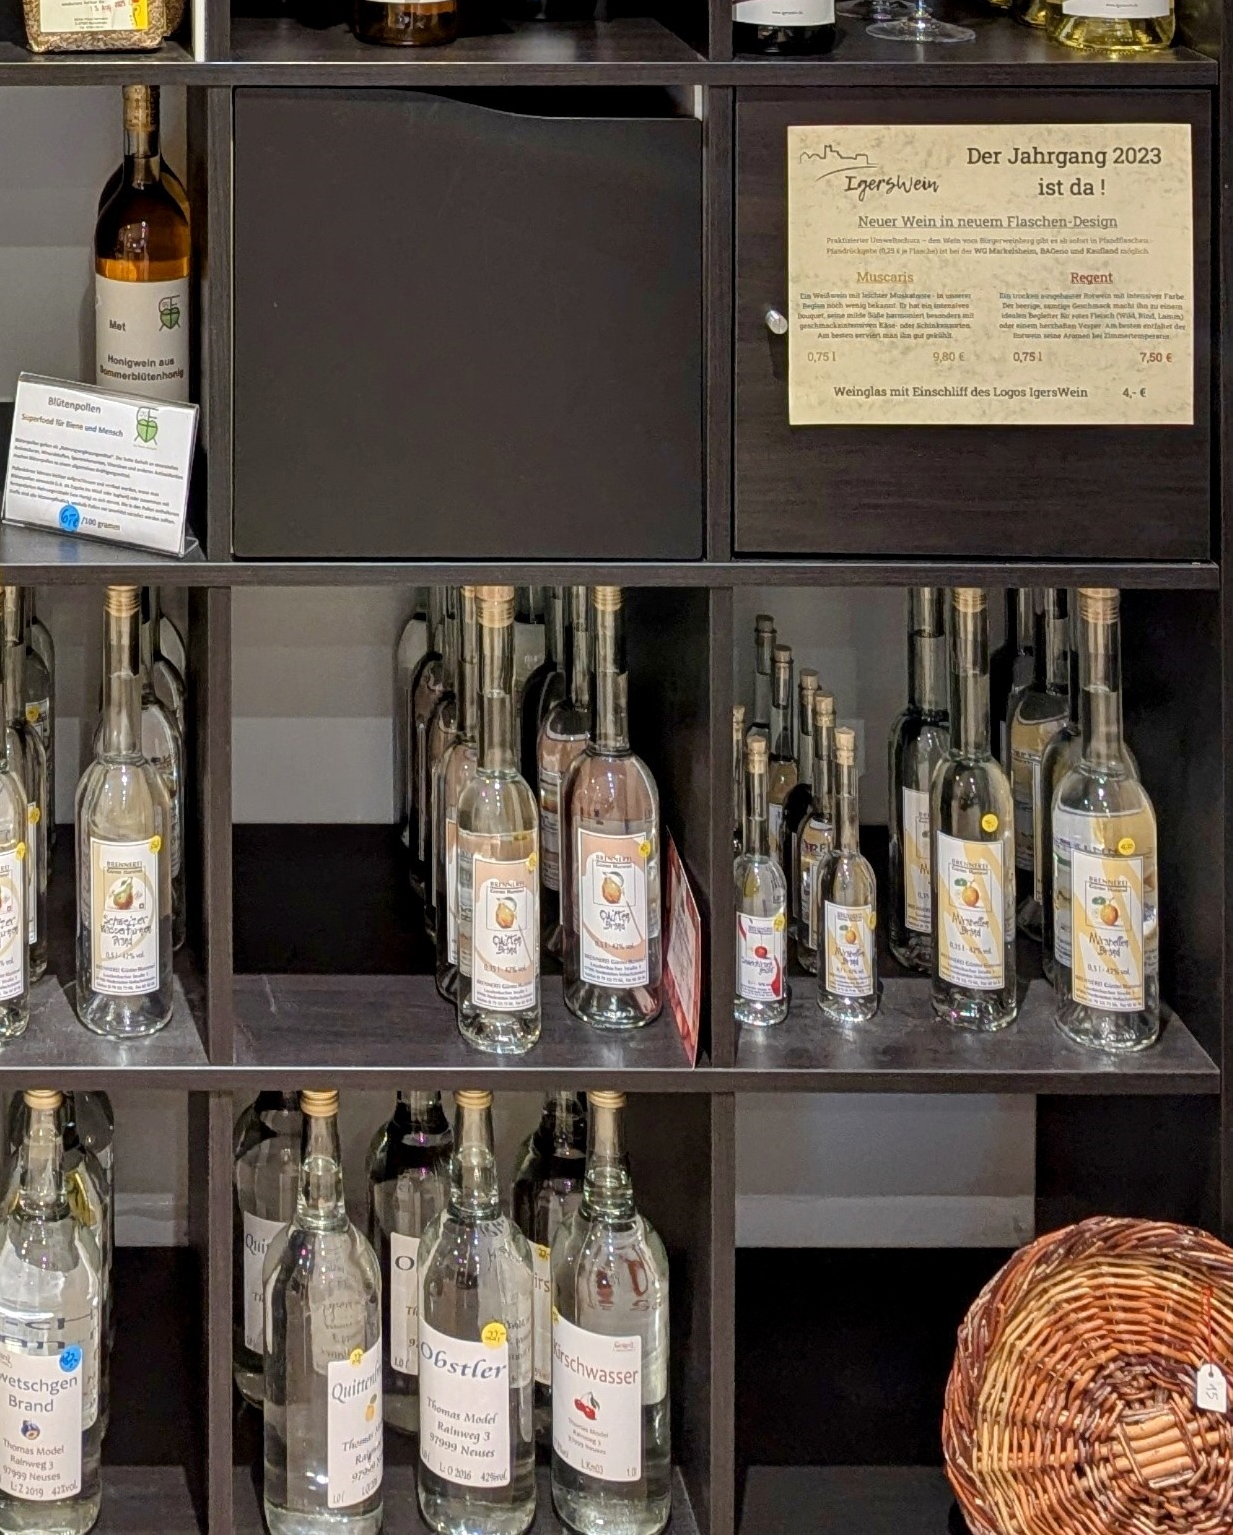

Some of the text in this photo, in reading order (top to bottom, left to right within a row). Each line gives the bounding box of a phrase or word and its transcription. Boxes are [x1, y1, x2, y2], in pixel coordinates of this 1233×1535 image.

[967, 148, 1162, 168] Der Jahrgang 2023
[845, 175, 939, 202] IgersWein
[1038, 179, 1094, 196] ist da
[858, 216, 1117, 229] Neuer Wein in neuem Flaschen-Design
[857, 272, 914, 283] Muscaris
[1071, 272, 1113, 284] Regent
[109, 319, 126, 331] Met
[107, 355, 175, 369] Honigwein aus
[808, 352, 829, 362] 0,75
[933, 352, 965, 362] 9,80 €
[1013, 352, 1035, 362] 0,75
[1140, 353, 1172, 363] 7,50 €
[833, 386, 887, 399] Weinglas
[890, 386, 909, 398] mit
[913, 386, 967, 399] Einschliff
[971, 386, 990, 398] des
[994, 386, 1026, 400] Logos
[1029, 386, 1088, 399] IgersWein
[1140, 388, 1146, 398] €
[48, 397, 101, 413] Blütenpollen
[22, 414, 54, 425] Superfood
[56, 418, 64, 427] für
[85, 424, 97, 433] und
[99, 427, 123, 437] Mensch
[420, 1341, 506, 1379] Obstler
[553, 1339, 639, 1384] Kirschwasser
[9, 1395, 54, 1413] Brand
[427, 1397, 498, 1425] Thomas Model
[437, 1420, 490, 1444] Rainweg 3
[3, 1438, 64, 1456] Thomas Model
[429, 1433, 495, 1459] 97999 Neuses
[10, 1455, 54, 1470] Rainweg 3
[3, 1465, 61, 1481] 97999 Neuses
[455, 1469, 472, 1480] 2016
[26, 1485, 44, 1497] 2019
